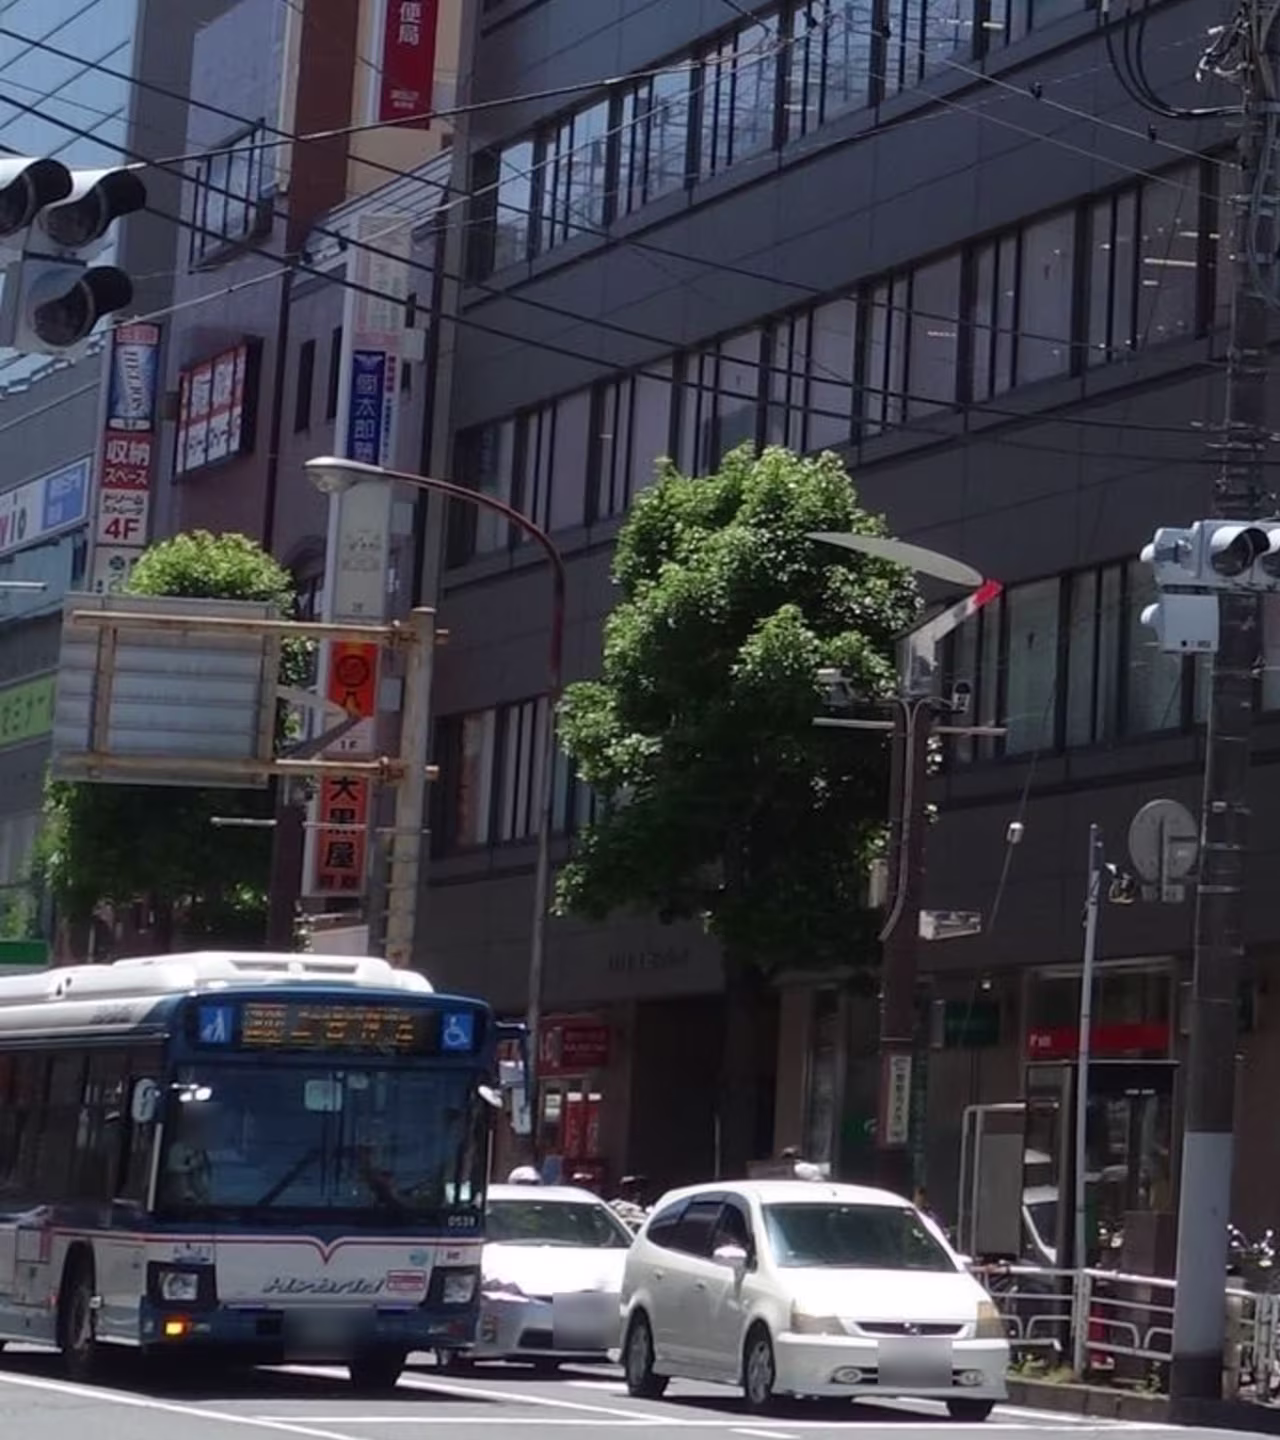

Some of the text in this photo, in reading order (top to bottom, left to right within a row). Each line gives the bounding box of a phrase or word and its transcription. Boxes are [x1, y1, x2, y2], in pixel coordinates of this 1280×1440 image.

[107, 440, 150, 467] 収納
[106, 467, 147, 485] スペース
[105, 518, 139, 540] 4F
[325, 776, 358, 869] 大黒屋
